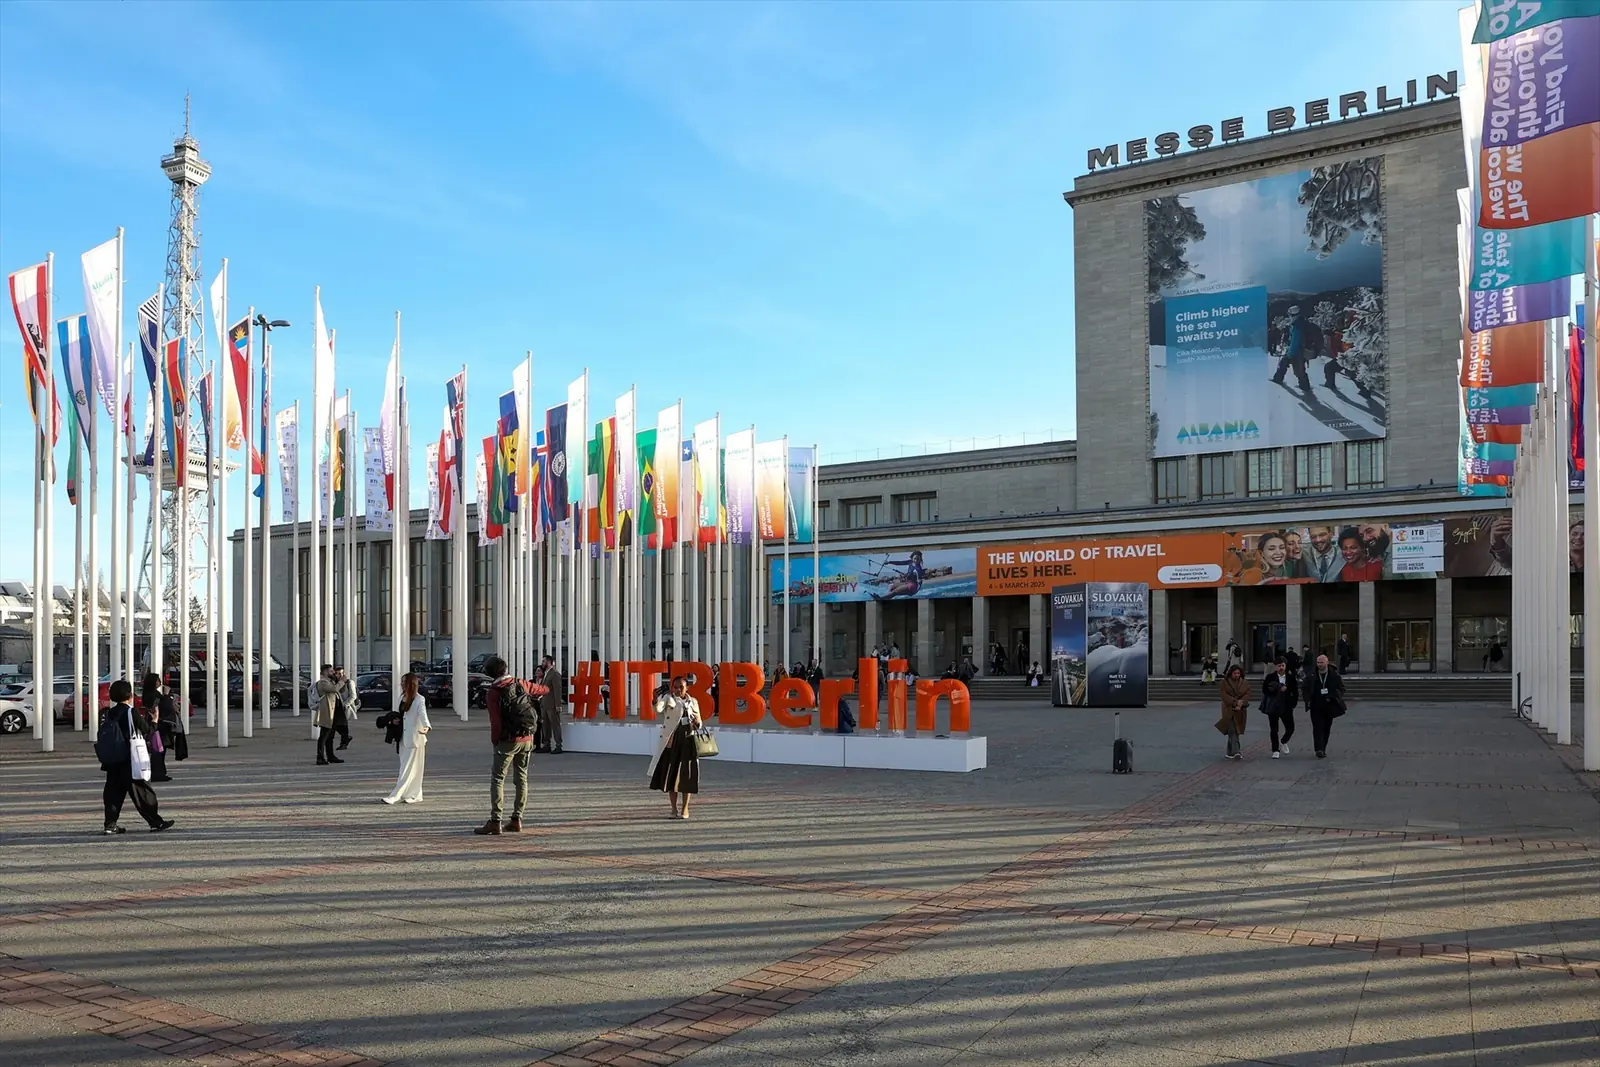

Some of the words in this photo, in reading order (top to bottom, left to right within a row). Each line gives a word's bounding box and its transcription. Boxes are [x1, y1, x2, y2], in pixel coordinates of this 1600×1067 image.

[1088, 117, 1244, 169] MESSE
[1268, 70, 1458, 132] BERLIN
[1176, 310, 1208, 322] Climb
[1212, 304, 1250, 317] higher
[1176, 323, 1194, 332] the
[1197, 320, 1217, 330] sea
[1177, 332, 1214, 343] awaits
[1216, 328, 1238, 339] you
[988, 552, 1014, 564] THE
[1020, 548, 1075, 564] WORLD
[1080, 548, 1100, 561] OF
[1105, 544, 1165, 558] TRAVEL
[989, 566, 1028, 580] LIVES
[1034, 564, 1076, 578] HERE.
[1054, 594, 1084, 604] SLOVAKIA
[1092, 593, 1143, 602] SLOVAKIA
